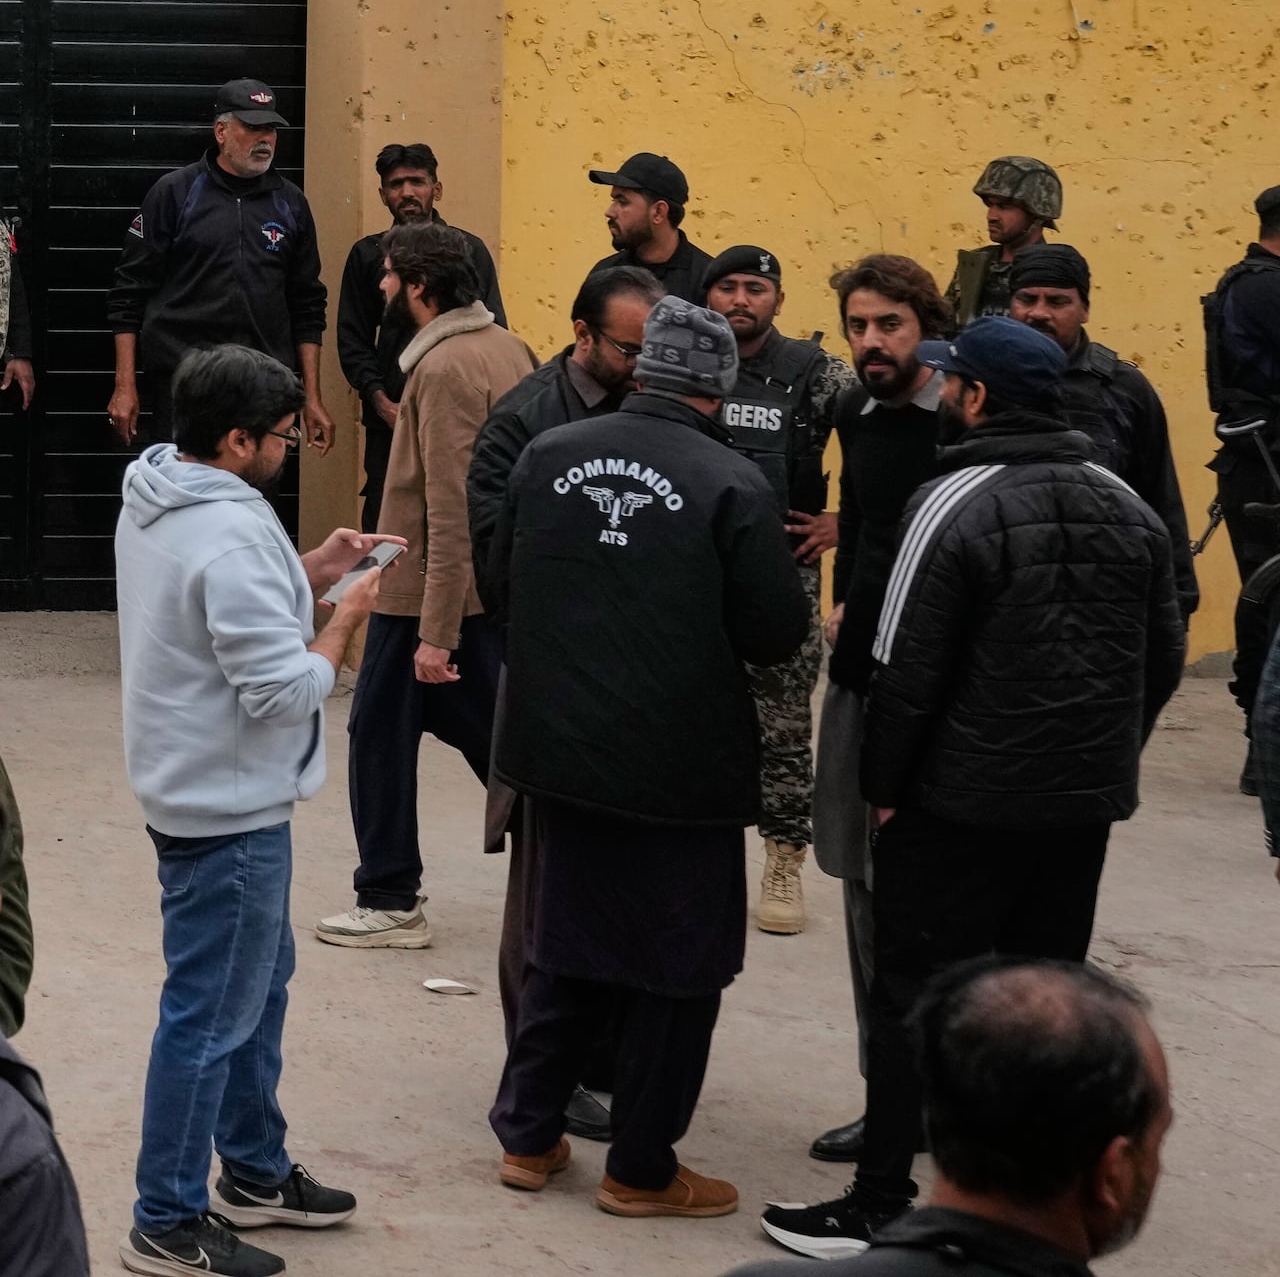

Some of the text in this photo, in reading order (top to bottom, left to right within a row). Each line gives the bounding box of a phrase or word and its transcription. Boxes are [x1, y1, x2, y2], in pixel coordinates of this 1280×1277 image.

[699, 336, 713, 350] S
[663, 348, 680, 364] S
[722, 403, 782, 432] GERS
[552, 458, 684, 512] COMMANDO
[599, 529, 629, 546] ATS
